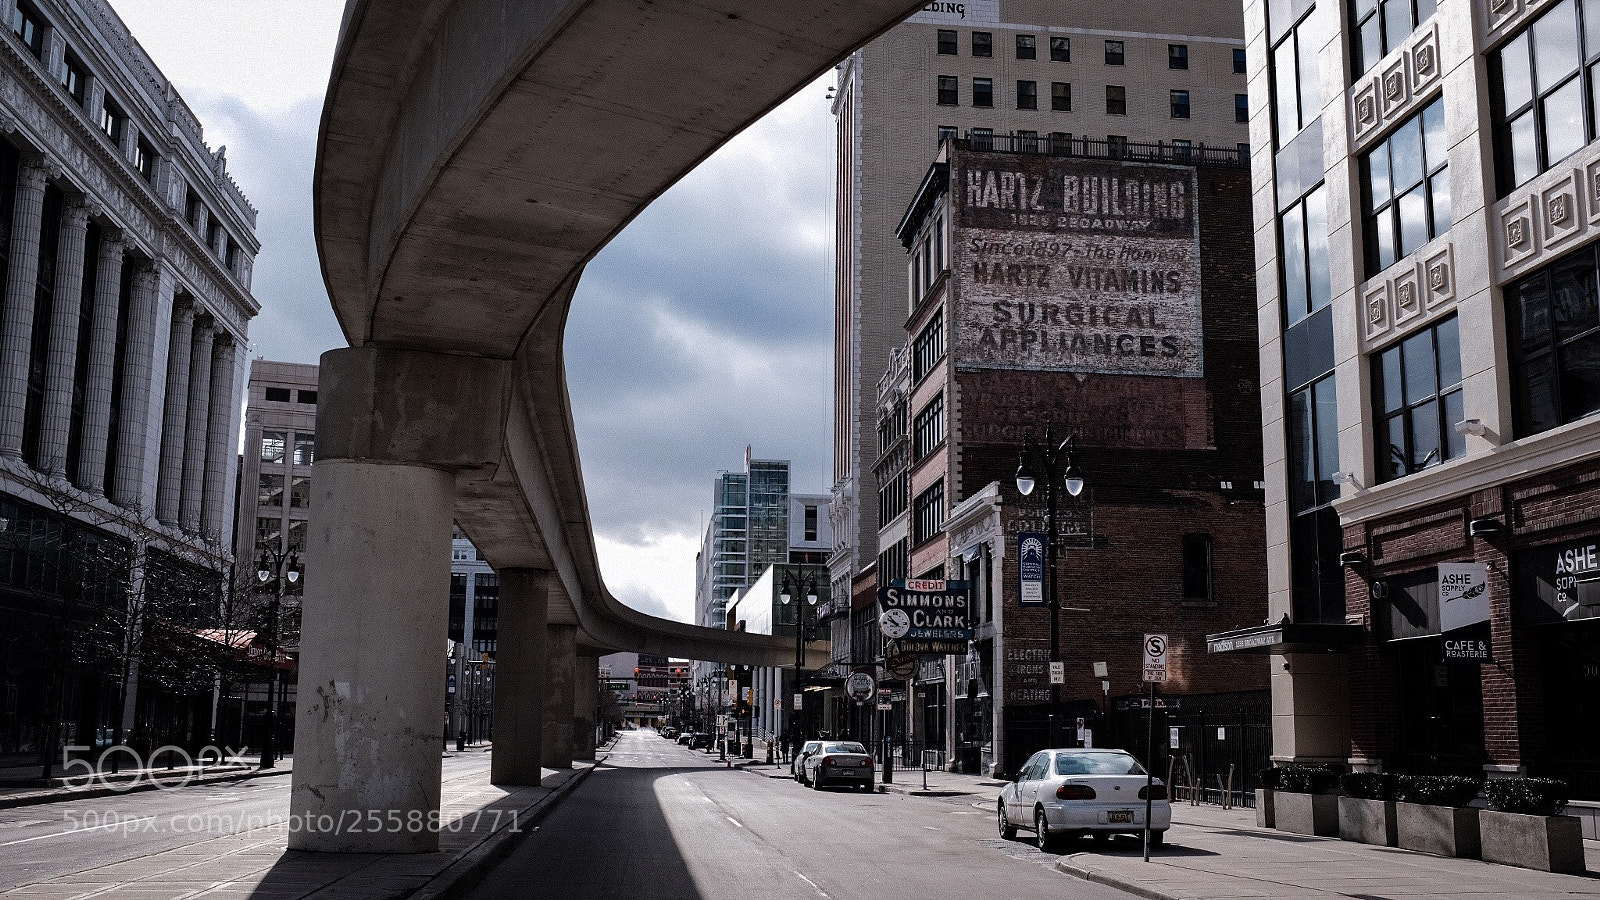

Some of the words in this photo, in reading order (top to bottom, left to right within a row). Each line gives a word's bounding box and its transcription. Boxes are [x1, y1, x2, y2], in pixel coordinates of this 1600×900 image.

[966, 169, 1045, 211] HARTZ
[1063, 174, 1186, 220] BUILDING
[1057, 215, 1152, 231] BROADWAY
[969, 238, 1025, 257] Since
[974, 261, 1051, 288] HARTZ
[1067, 265, 1183, 293] VITAMINS
[992, 299, 1166, 330] SURGICAL
[979, 327, 1181, 358] APPLIANCES
[1555, 544, 1598, 575] ASHE
[908, 580, 944, 590] CREDIT
[1442, 574, 1471, 584] ASHE
[1441, 584, 1465, 592] SUPPLY
[886, 588, 965, 607] SIMMONS
[913, 609, 965, 628] CLARK
[910, 630, 964, 638] JEWELERS
[1445, 640, 1474, 651] CAFE
[1478, 641, 1486, 650] &
[1007, 648, 1051, 661] ELECTRIC
[1446, 650, 1488, 658] ROASTERIE
[1017, 664, 1044, 674] IRONS
[1010, 688, 1051, 701] HEATING
